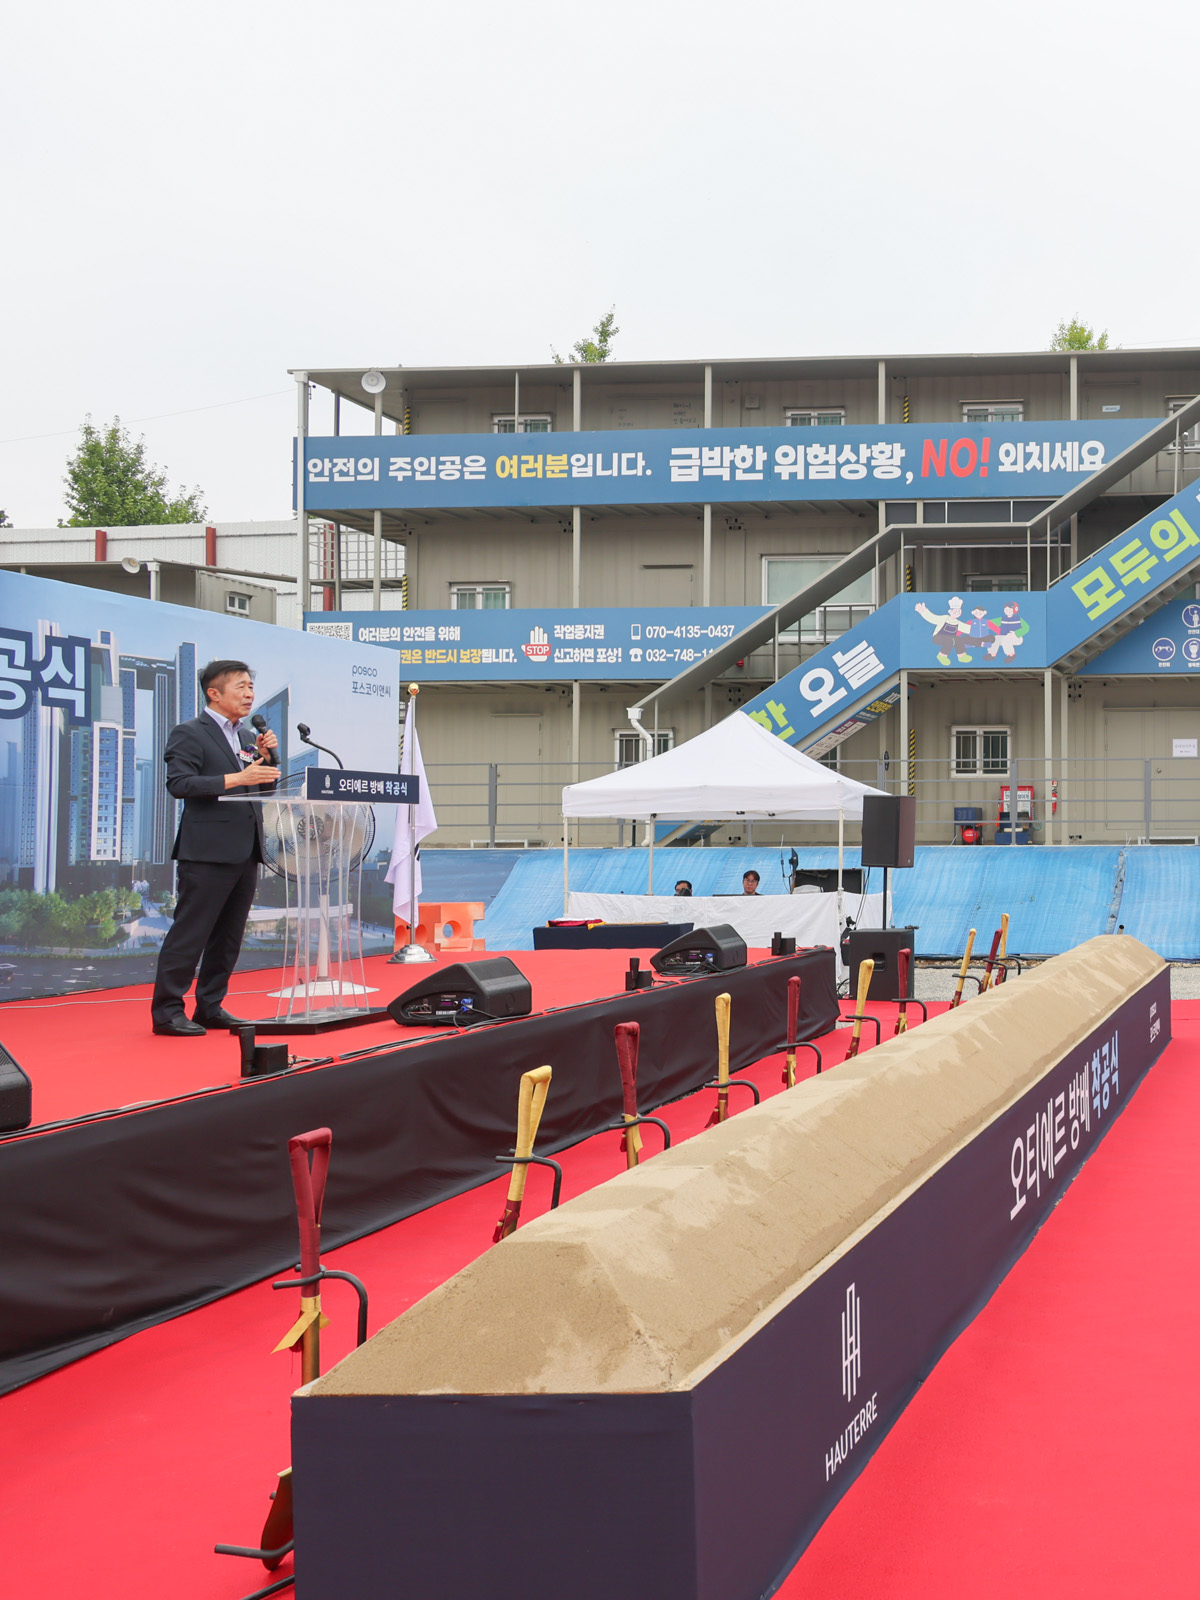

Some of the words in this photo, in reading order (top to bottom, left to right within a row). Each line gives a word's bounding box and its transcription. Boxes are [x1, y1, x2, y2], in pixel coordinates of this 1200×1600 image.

[307, 457, 379, 482] 안전의
[388, 454, 487, 481] 주인공은
[495, 451, 652, 479] 여러분입니다.
[669, 444, 767, 482] 급박한
[774, 441, 913, 485] 위험상황,
[920, 437, 991, 478] NO!
[998, 440, 1106, 473] 외치세요
[1071, 508, 1200, 621] 모두의
[358, 627, 400, 642] 여러분의
[403, 626, 436, 641] 안전을
[438, 625, 460, 641] 위해
[554, 624, 604, 640] 작업중지권
[645, 624, 735, 639] 070-4135-0437
[425, 648, 457, 664] 반드시
[460, 646, 517, 663] 보장됩니다.
[526, 645, 550, 656] STOP
[554, 648, 594, 663] 신고하면
[596, 647, 622, 663] 포상!
[352, 665, 378, 677] posco
[799, 640, 885, 718] 오늘
[351, 681, 392, 698] 포스코이앤씨
[339, 778, 369, 794] 오티에르
[385, 780, 408, 796] 착공식
[1010, 1091, 1067, 1221] 오티에르
[1068, 1061, 1091, 1150] 방배
[1091, 1029, 1120, 1120] 착공식
[825, 1391, 878, 1482] HAUTERRE
